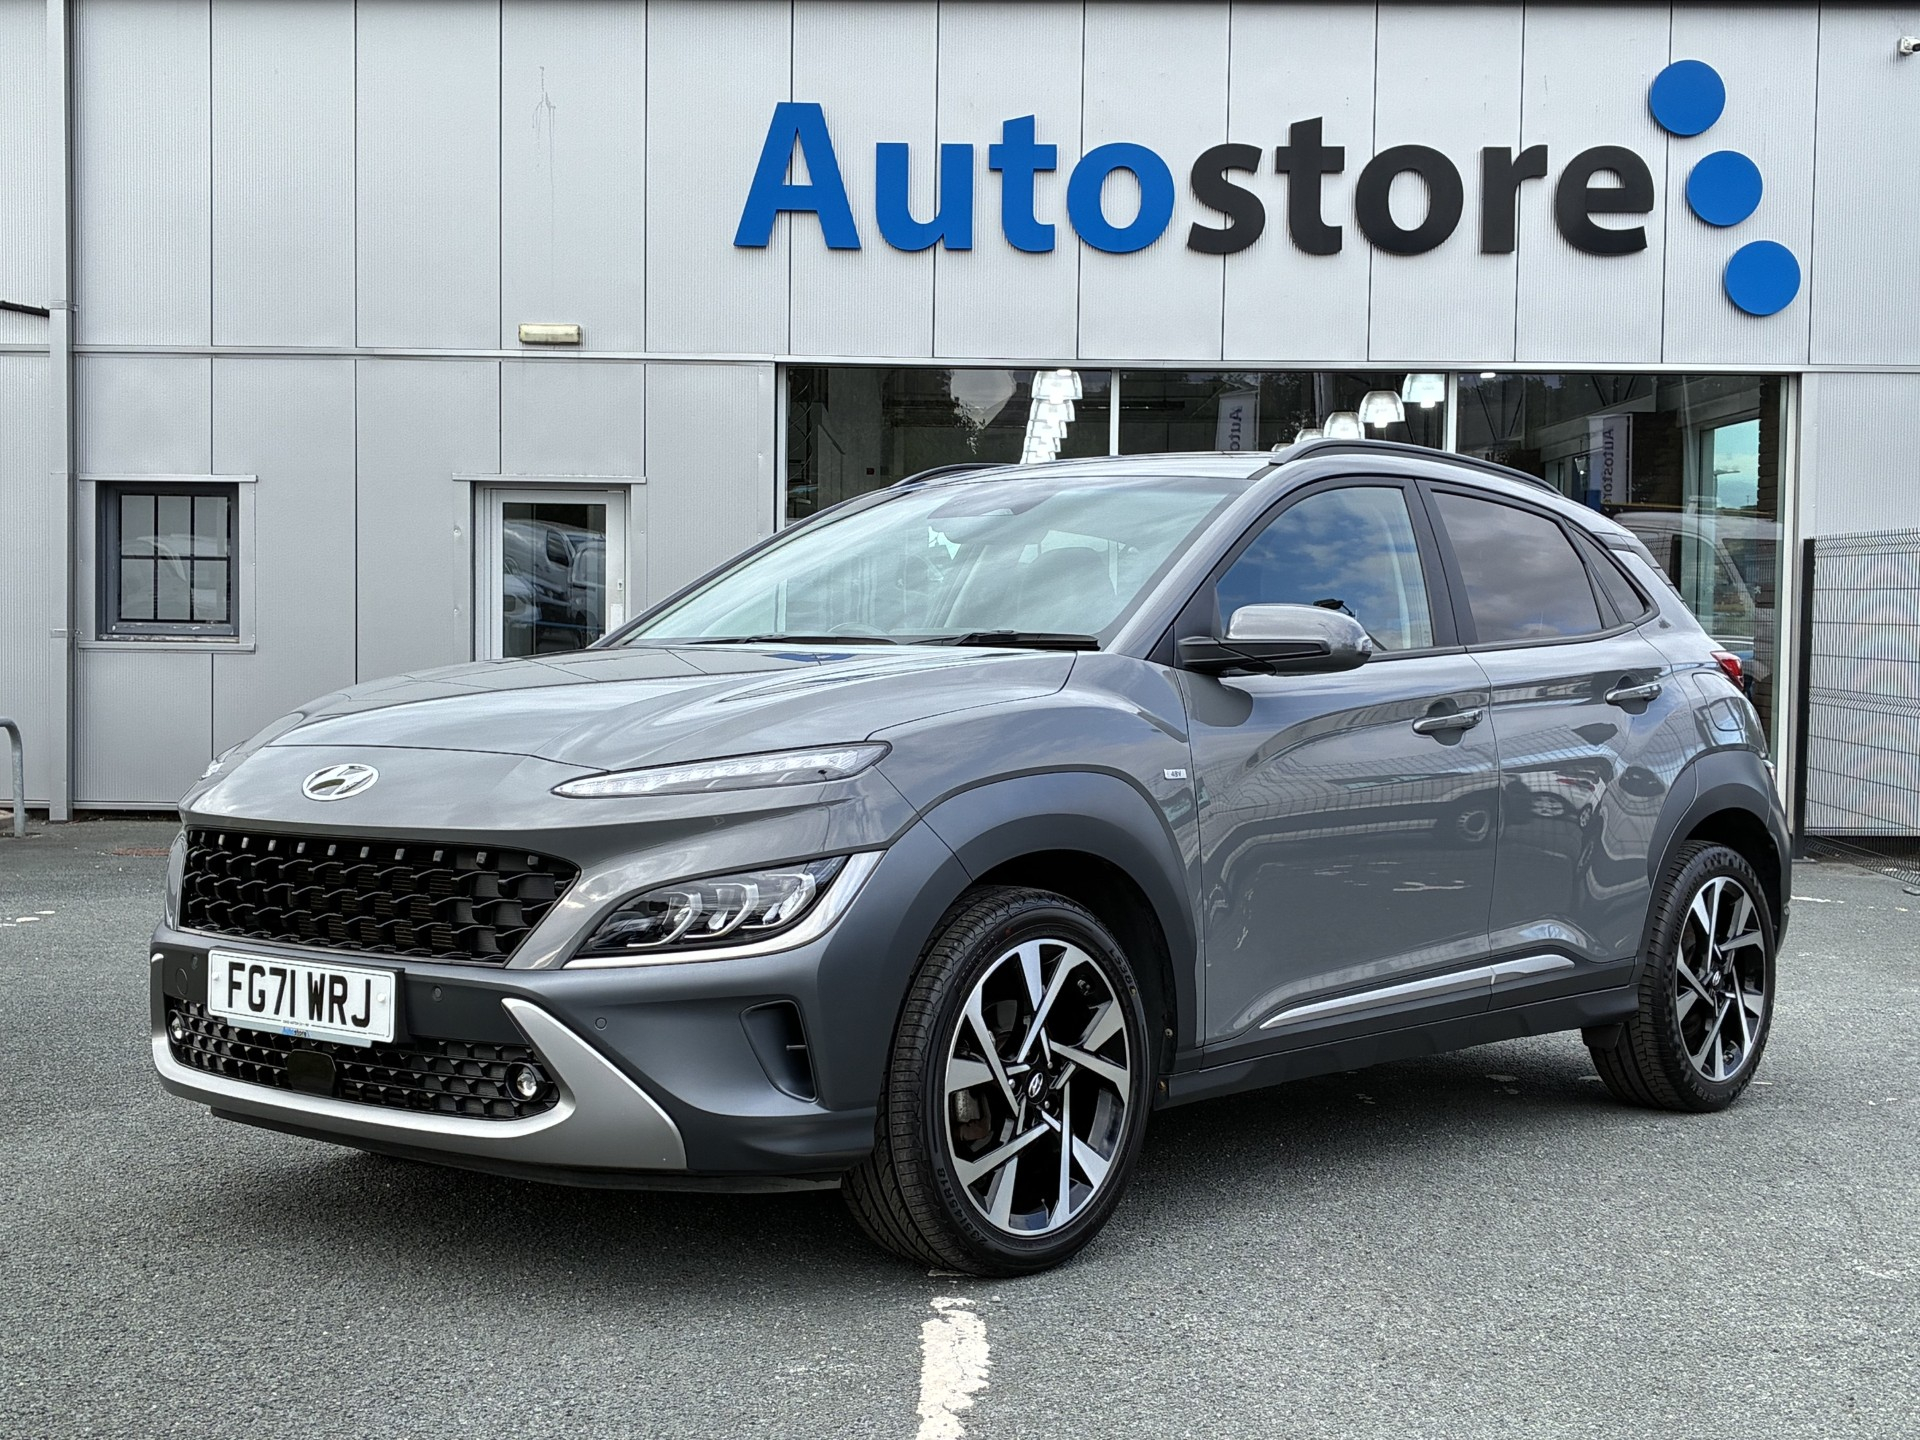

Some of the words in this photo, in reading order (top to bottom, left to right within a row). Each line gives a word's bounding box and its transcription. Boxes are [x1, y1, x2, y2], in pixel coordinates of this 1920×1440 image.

[733, 101, 1655, 256] Autostore
[228, 961, 296, 1018] FG71
[307, 971, 372, 1028] WRJ
